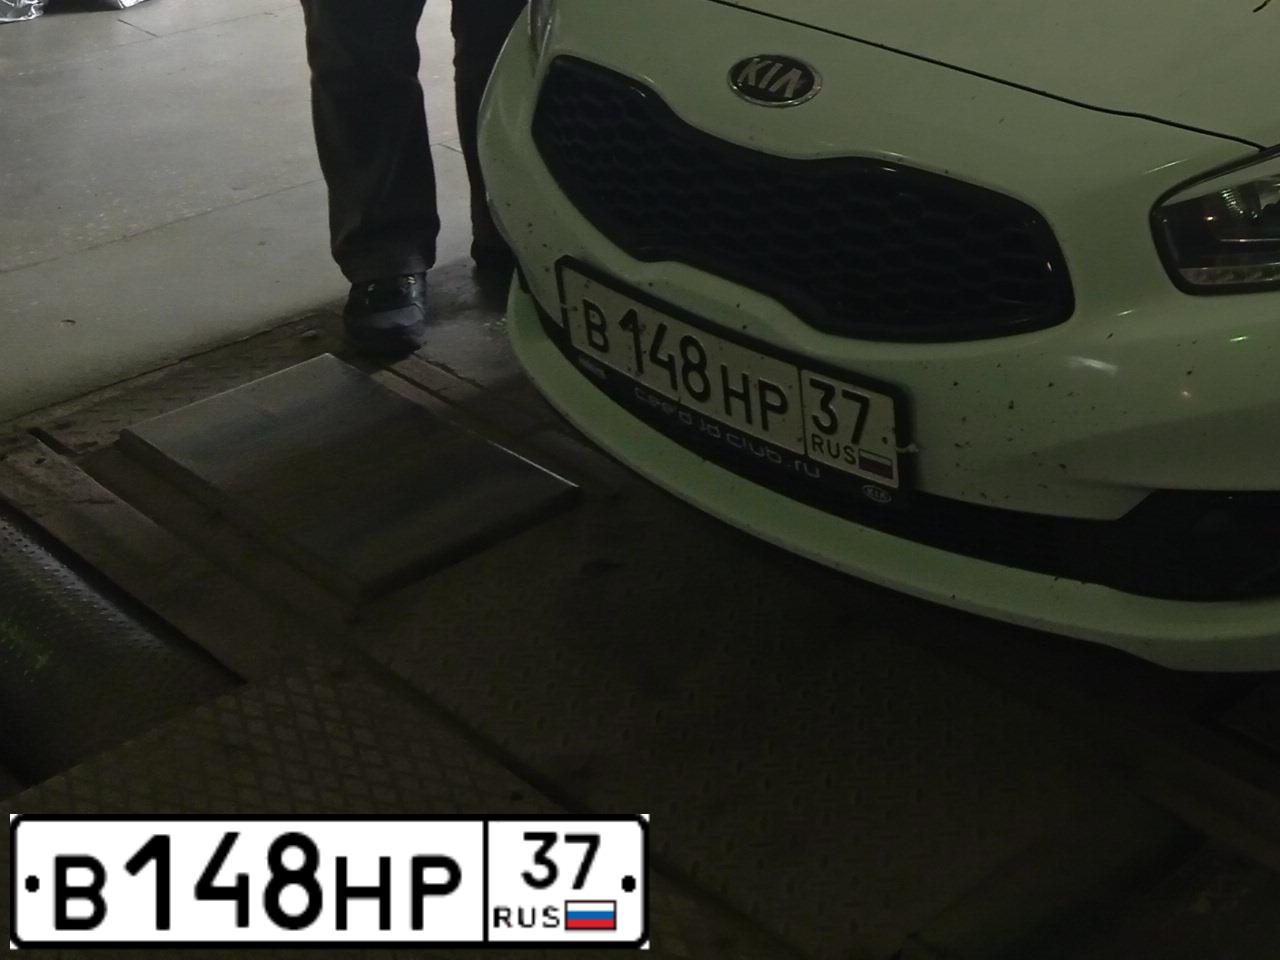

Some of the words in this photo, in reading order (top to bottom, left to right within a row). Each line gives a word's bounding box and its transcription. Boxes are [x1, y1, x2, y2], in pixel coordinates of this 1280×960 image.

[736, 55, 803, 98] KIA
[808, 378, 870, 444] 37
[811, 434, 857, 464] RUS
